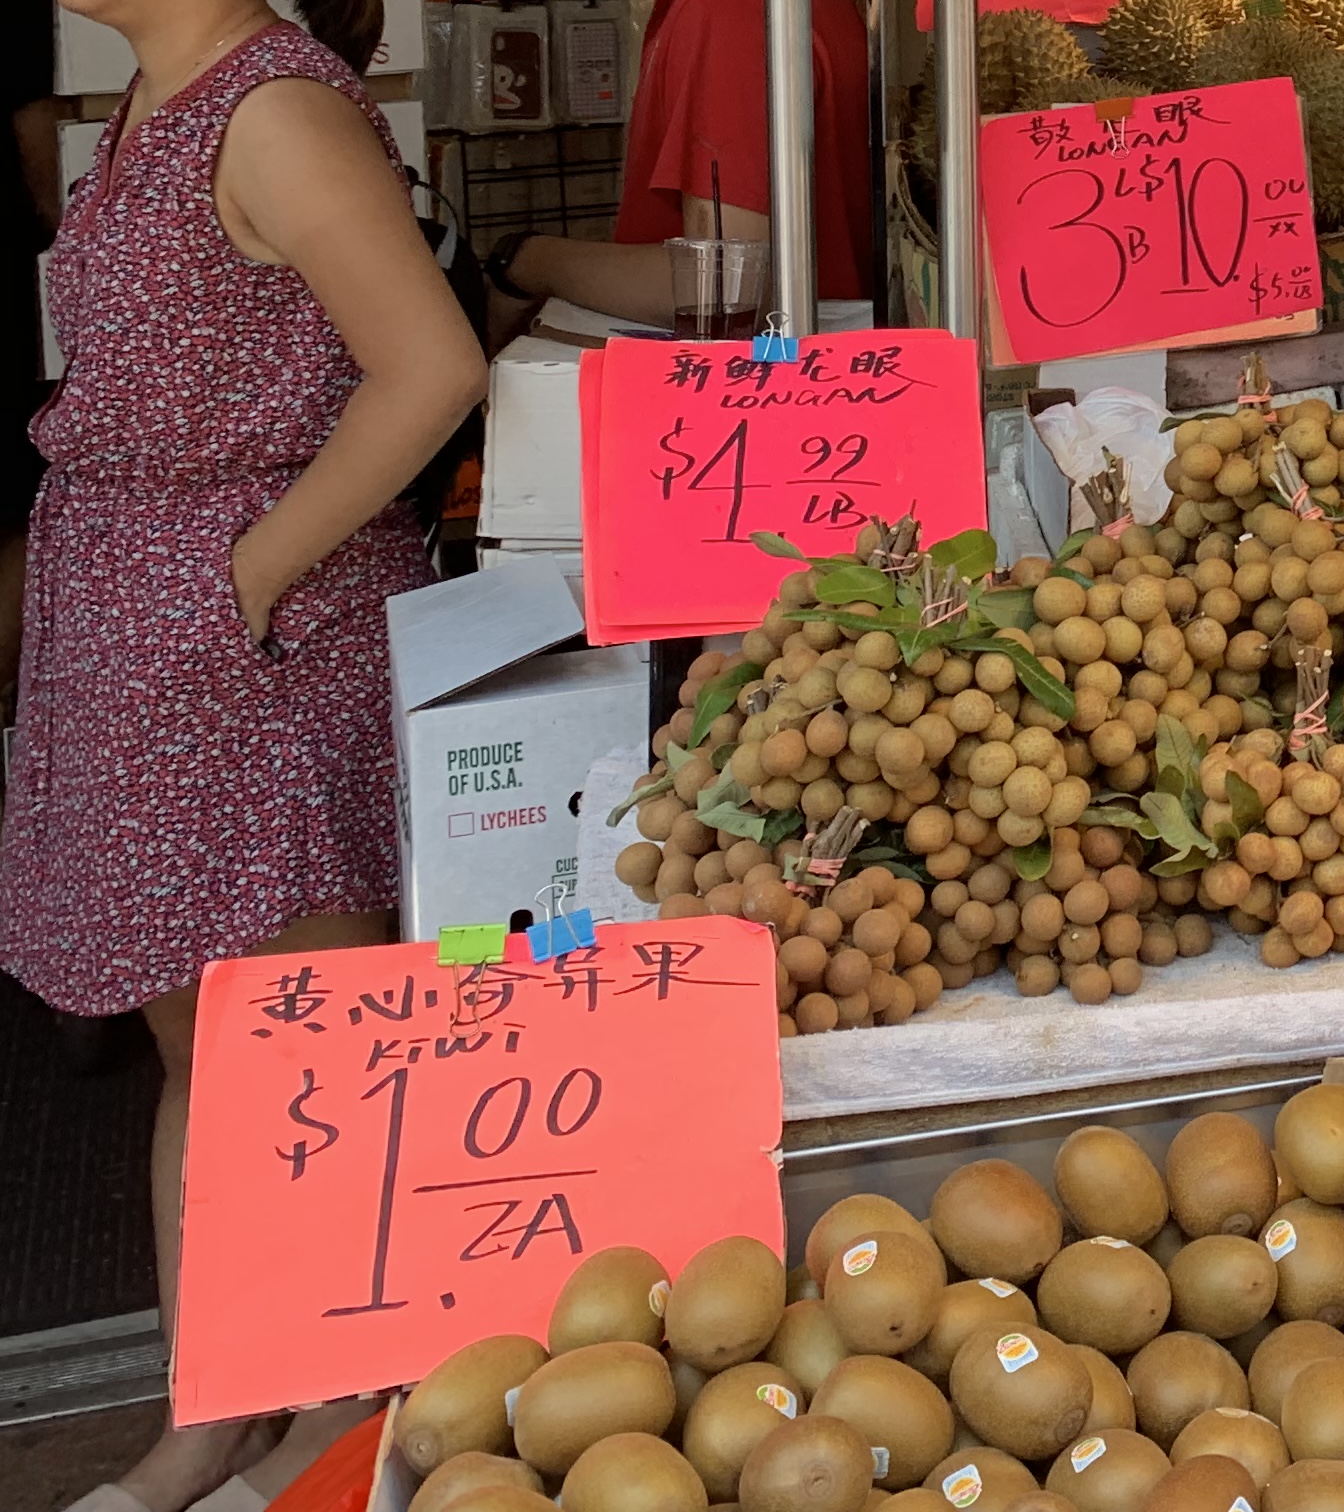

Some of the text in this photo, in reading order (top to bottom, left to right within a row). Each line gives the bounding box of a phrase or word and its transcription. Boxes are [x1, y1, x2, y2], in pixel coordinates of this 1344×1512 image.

[447, 741, 524, 772] PRODUCE
[448, 767, 524, 796] OF U.S.A.
[480, 805, 547, 832] LYCHEES
